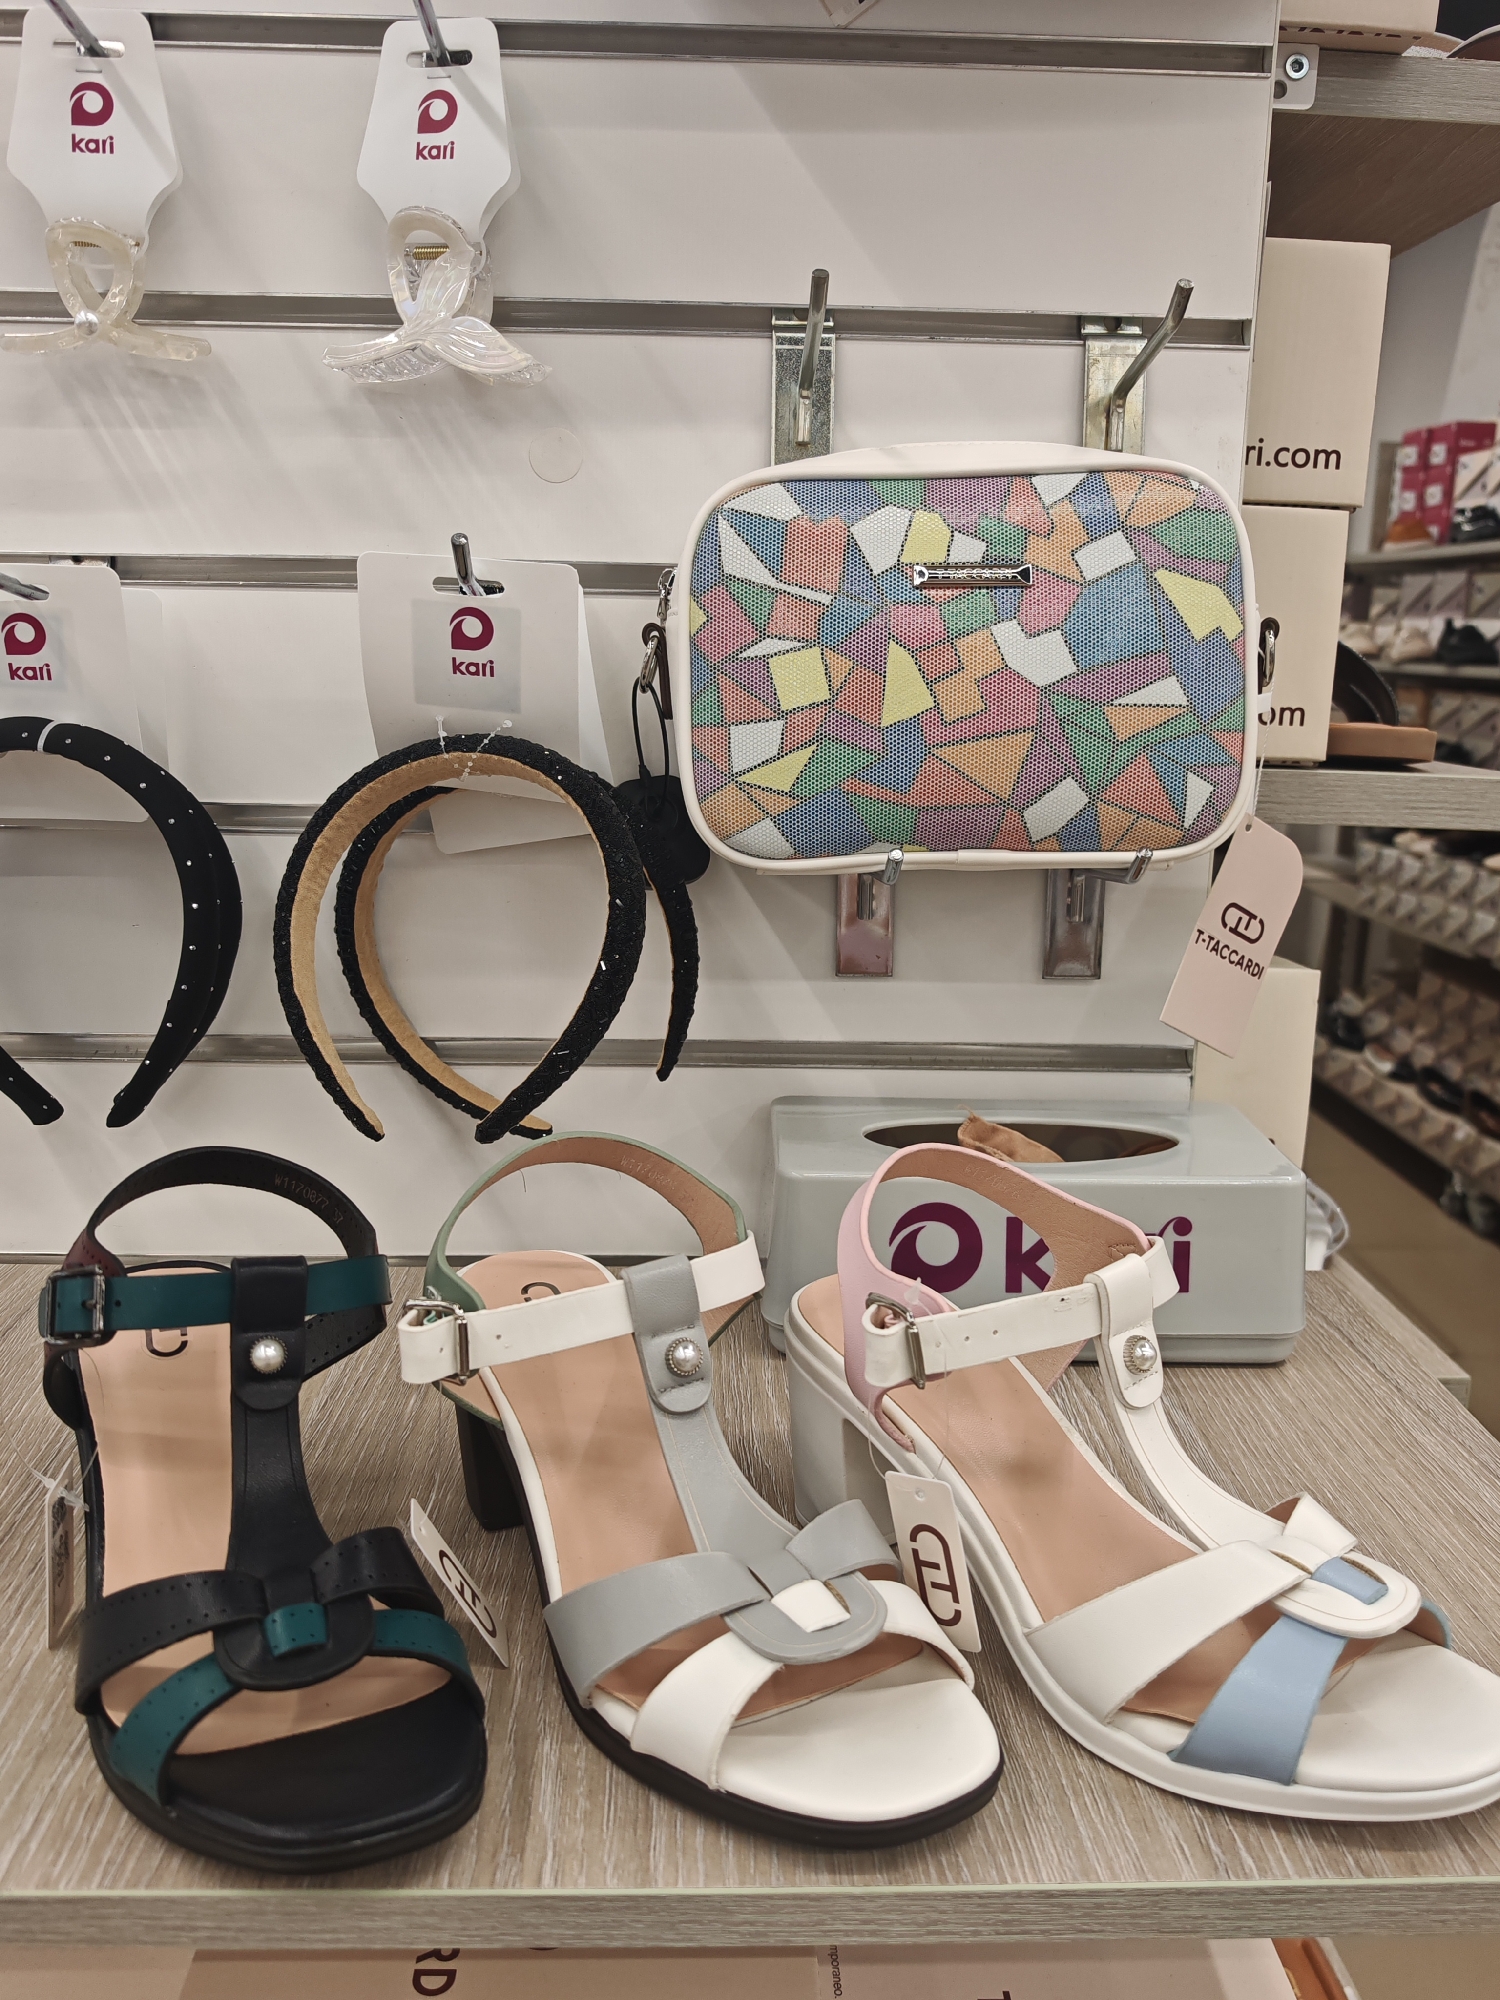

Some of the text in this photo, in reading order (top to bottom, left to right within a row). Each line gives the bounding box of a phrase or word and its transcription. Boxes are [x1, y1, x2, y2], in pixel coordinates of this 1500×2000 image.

[71, 133, 114, 154] kari
[416, 141, 455, 160] kari
[8, 663, 52, 681] kari
[452, 657, 495, 678] kari
[1195, 928, 1265, 980] T-TACCARDI
